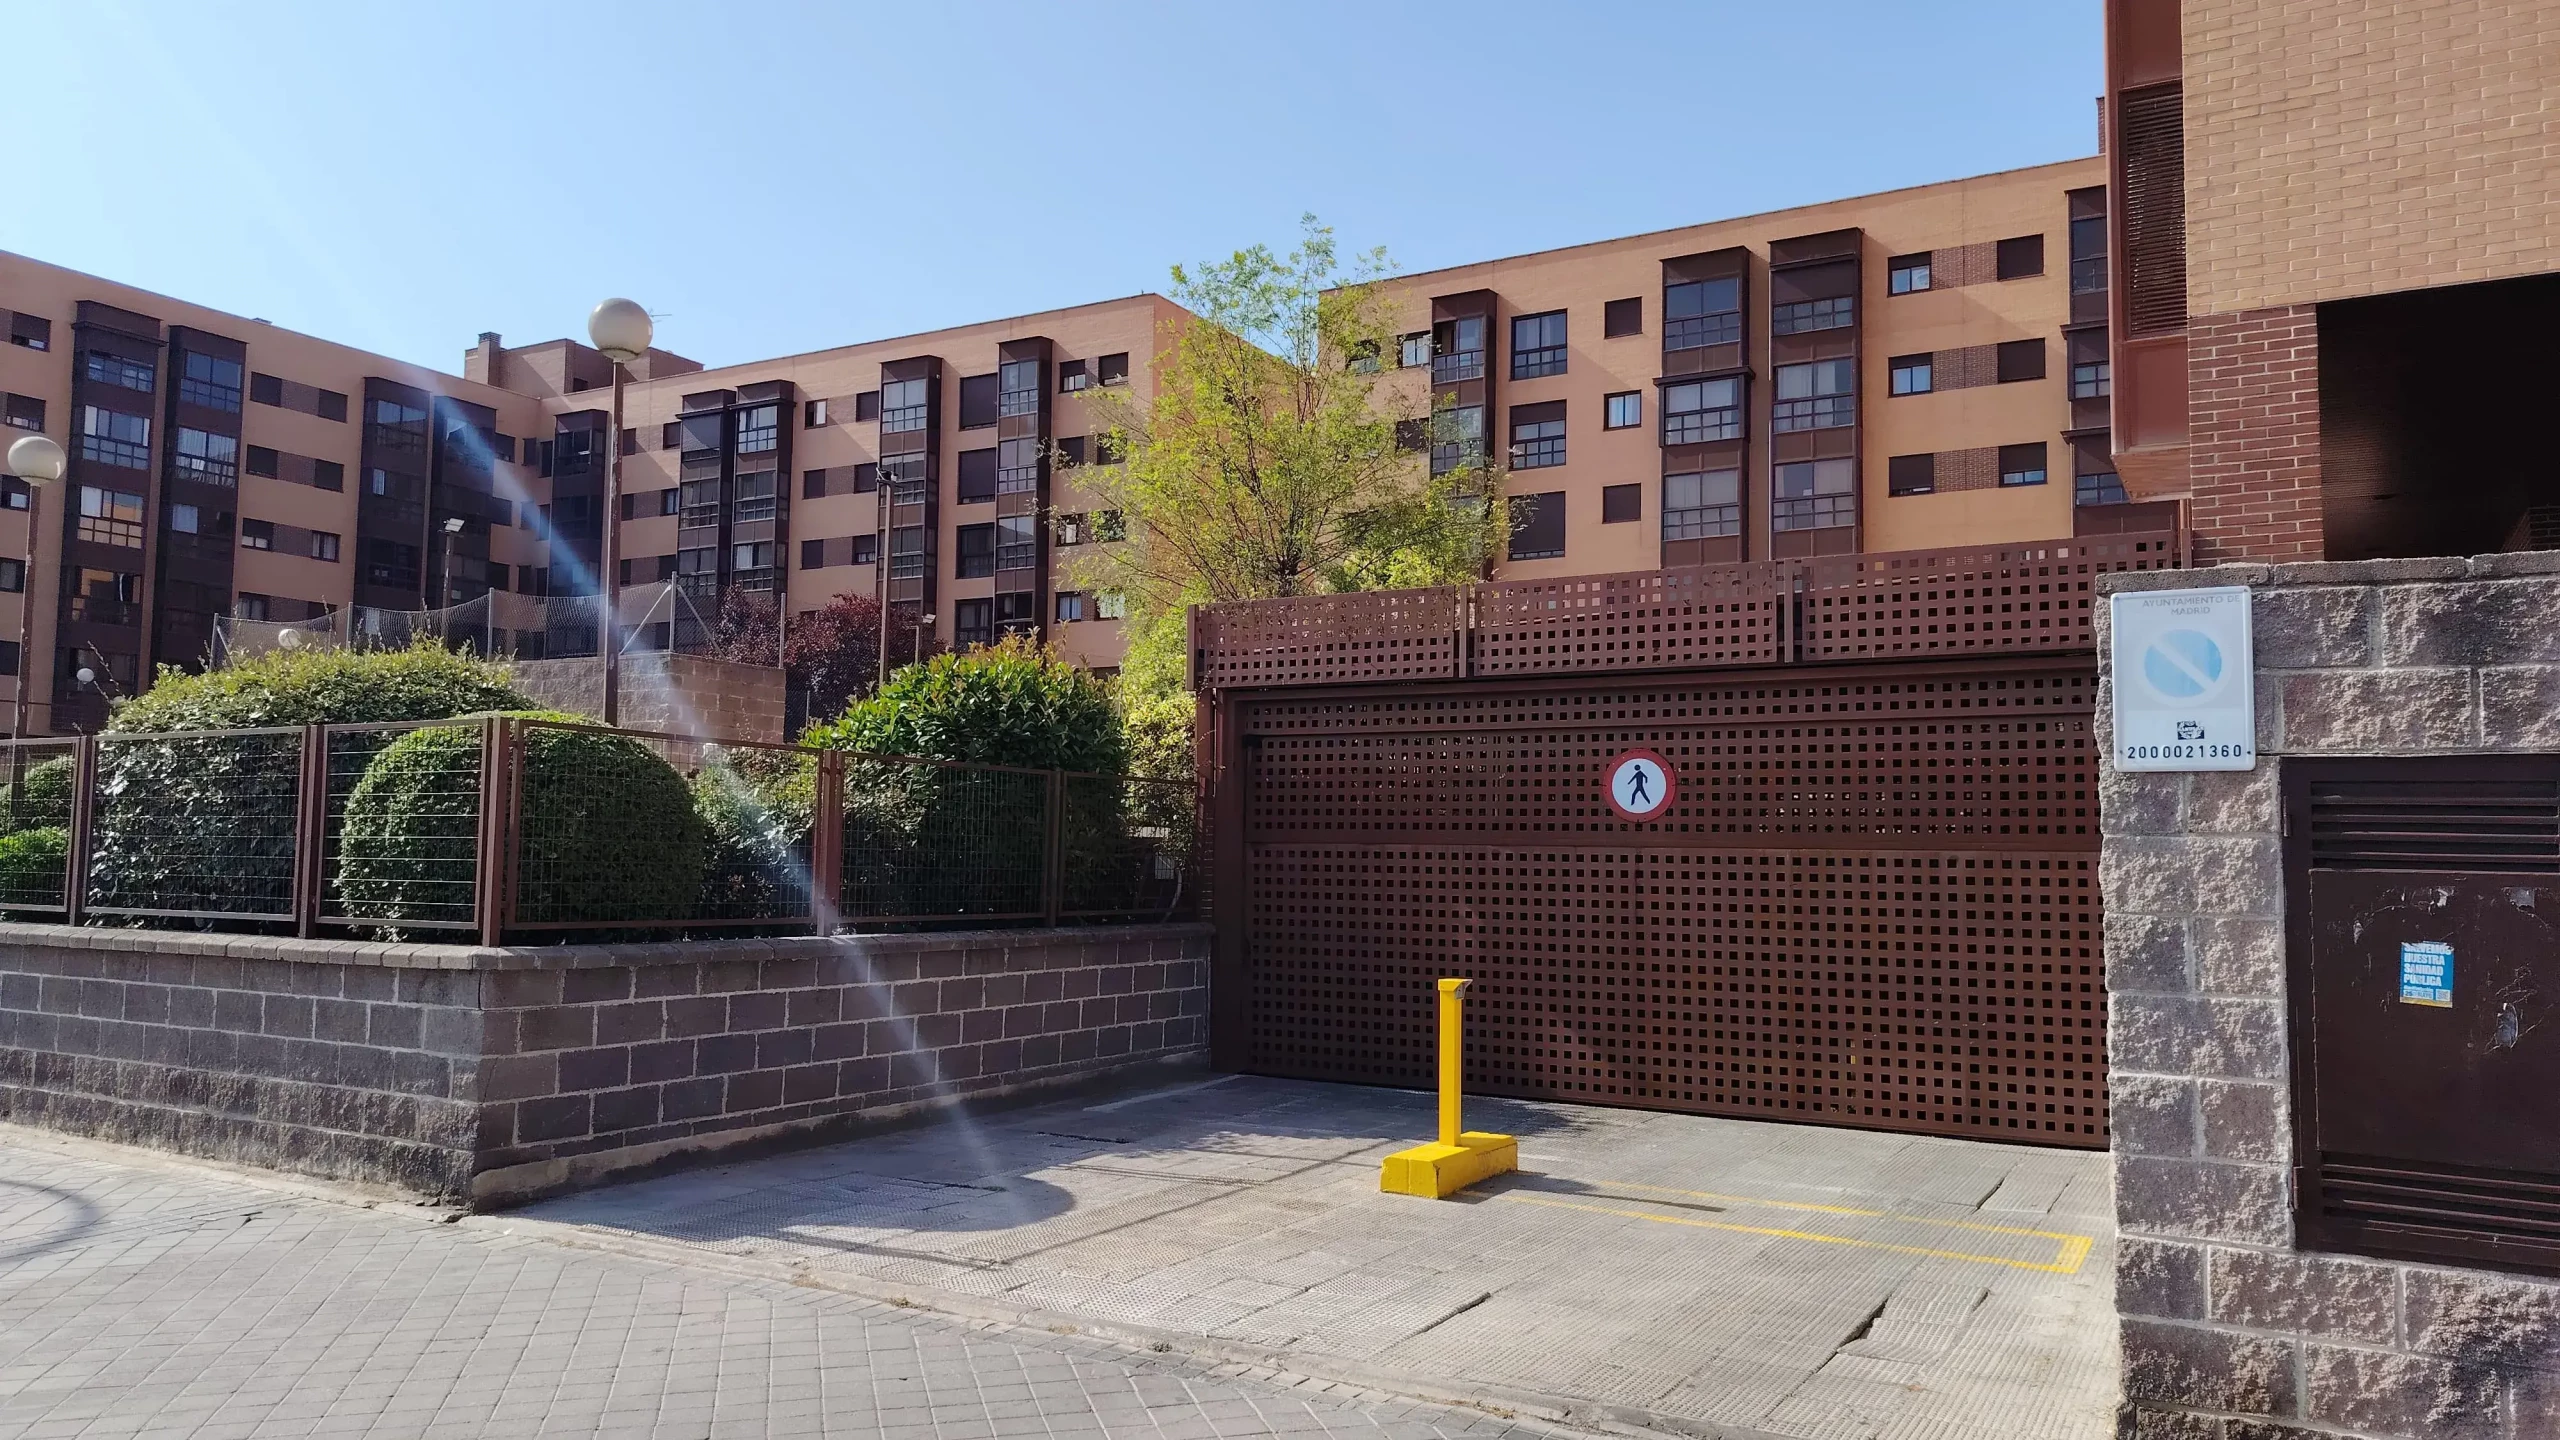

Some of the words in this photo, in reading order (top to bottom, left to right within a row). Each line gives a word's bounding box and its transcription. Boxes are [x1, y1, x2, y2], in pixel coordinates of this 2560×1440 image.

[2143, 596, 2223, 607] AYUNTAMIENTO
[2227, 595, 2240, 603] DE
[2170, 606, 2211, 615] MADRID
[2127, 745, 2242, 759] 2000021360
[2404, 952, 2445, 966] NUESTRA
[2404, 963, 2443, 976] SANIDAD
